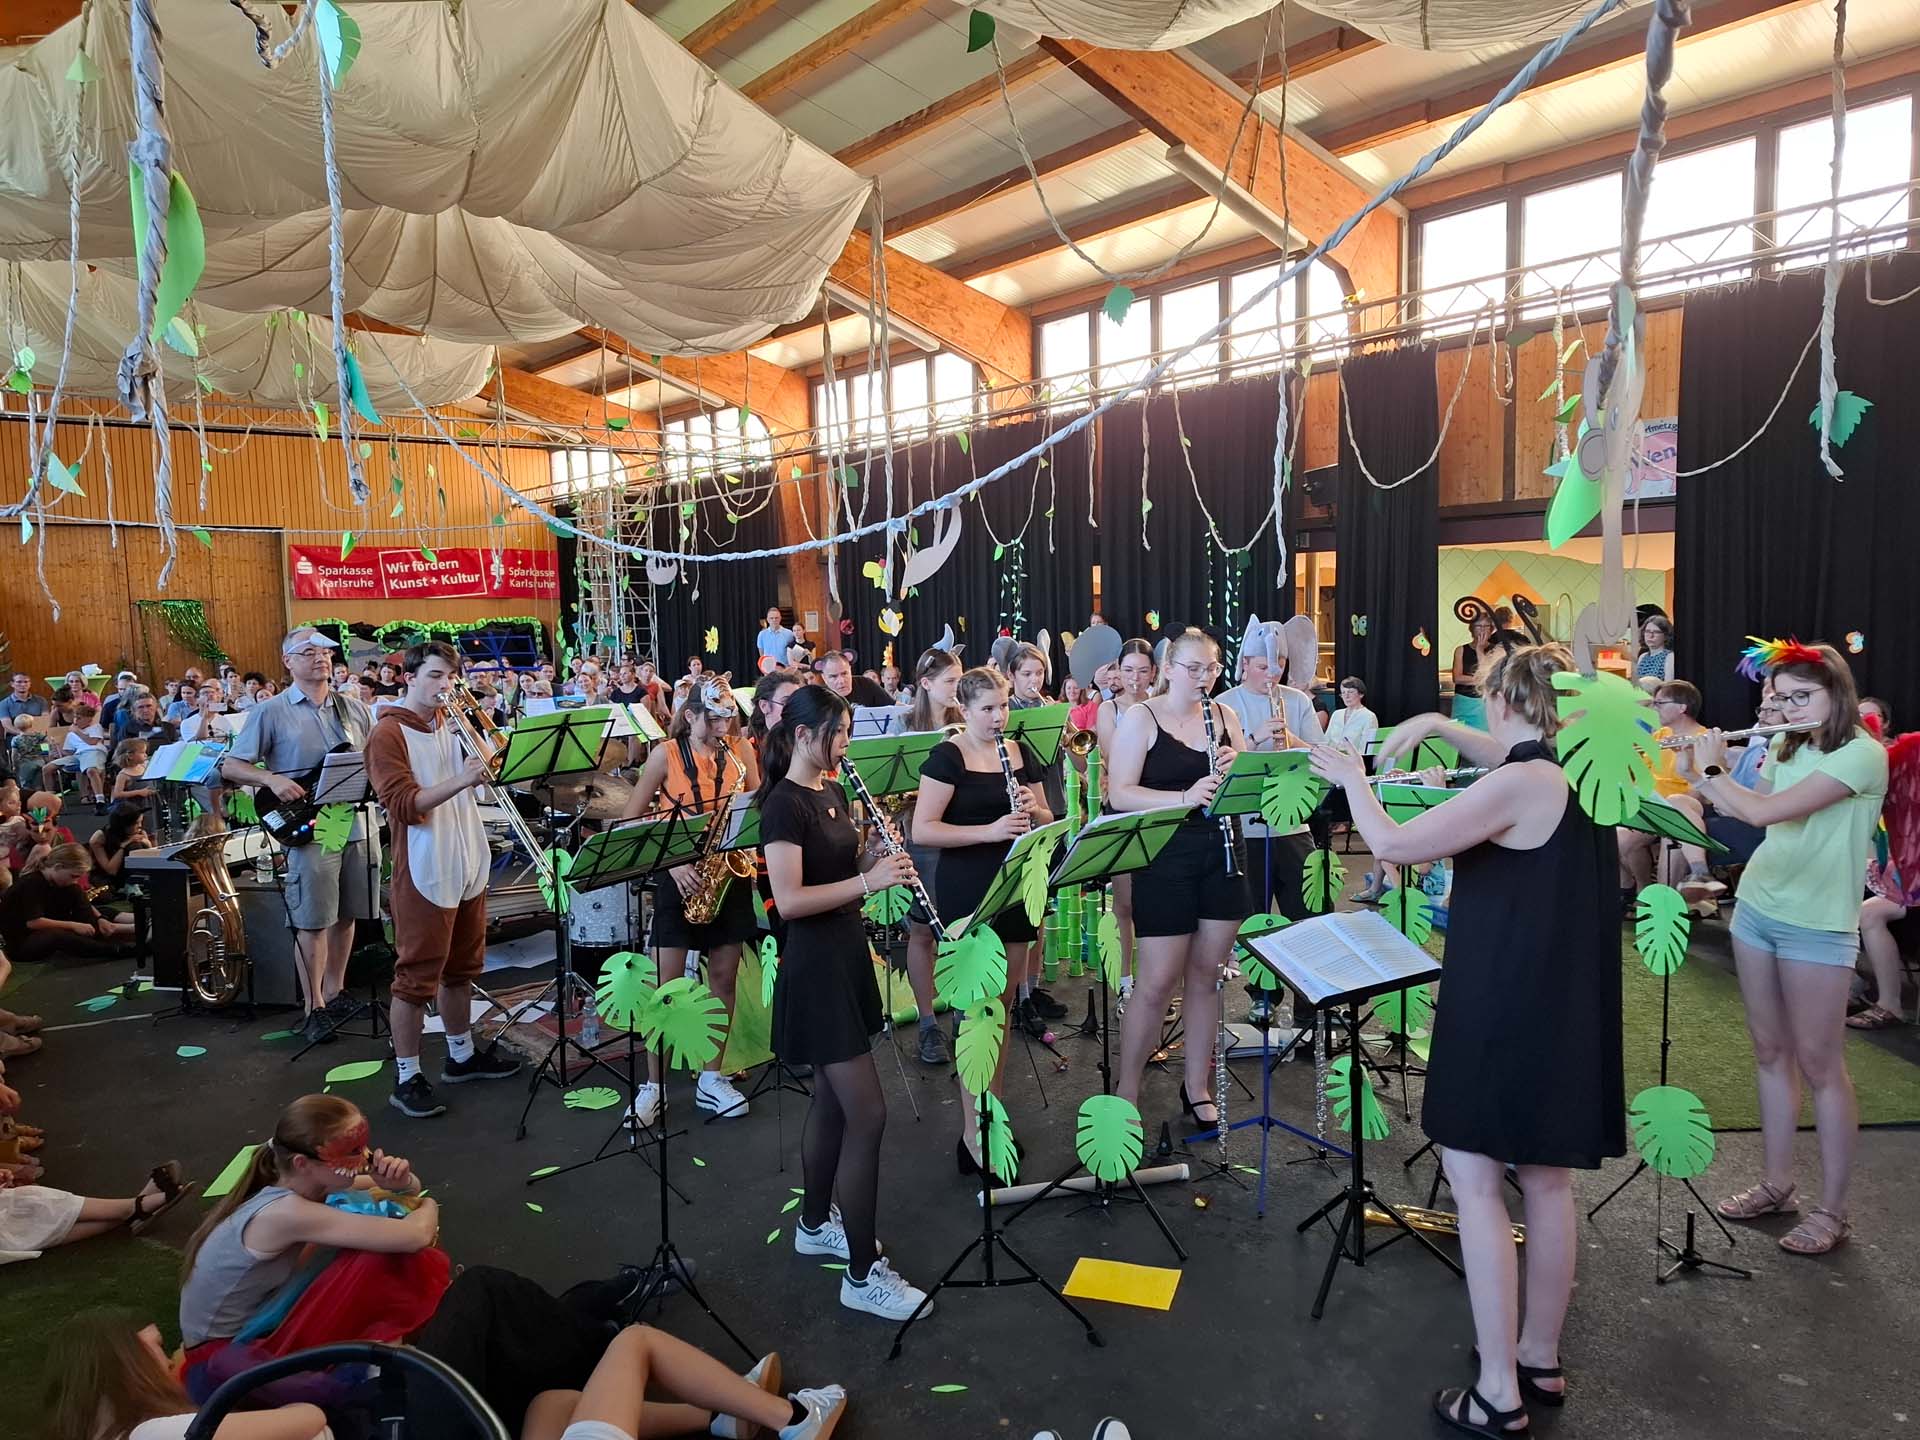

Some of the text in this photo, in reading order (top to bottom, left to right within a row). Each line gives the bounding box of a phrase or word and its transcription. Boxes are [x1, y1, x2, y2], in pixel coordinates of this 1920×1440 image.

[318, 565, 373, 577] Sparkasse
[386, 560, 460, 574] Wir fördern
[508, 567, 556, 578] Sparkasse
[320, 578, 375, 588] Karlsruhe
[389, 573, 480, 590] Kunst + Kultur
[509, 579, 557, 589] Karlsruhe
[823, 1230, 845, 1249] N
[866, 1286, 892, 1307] N
